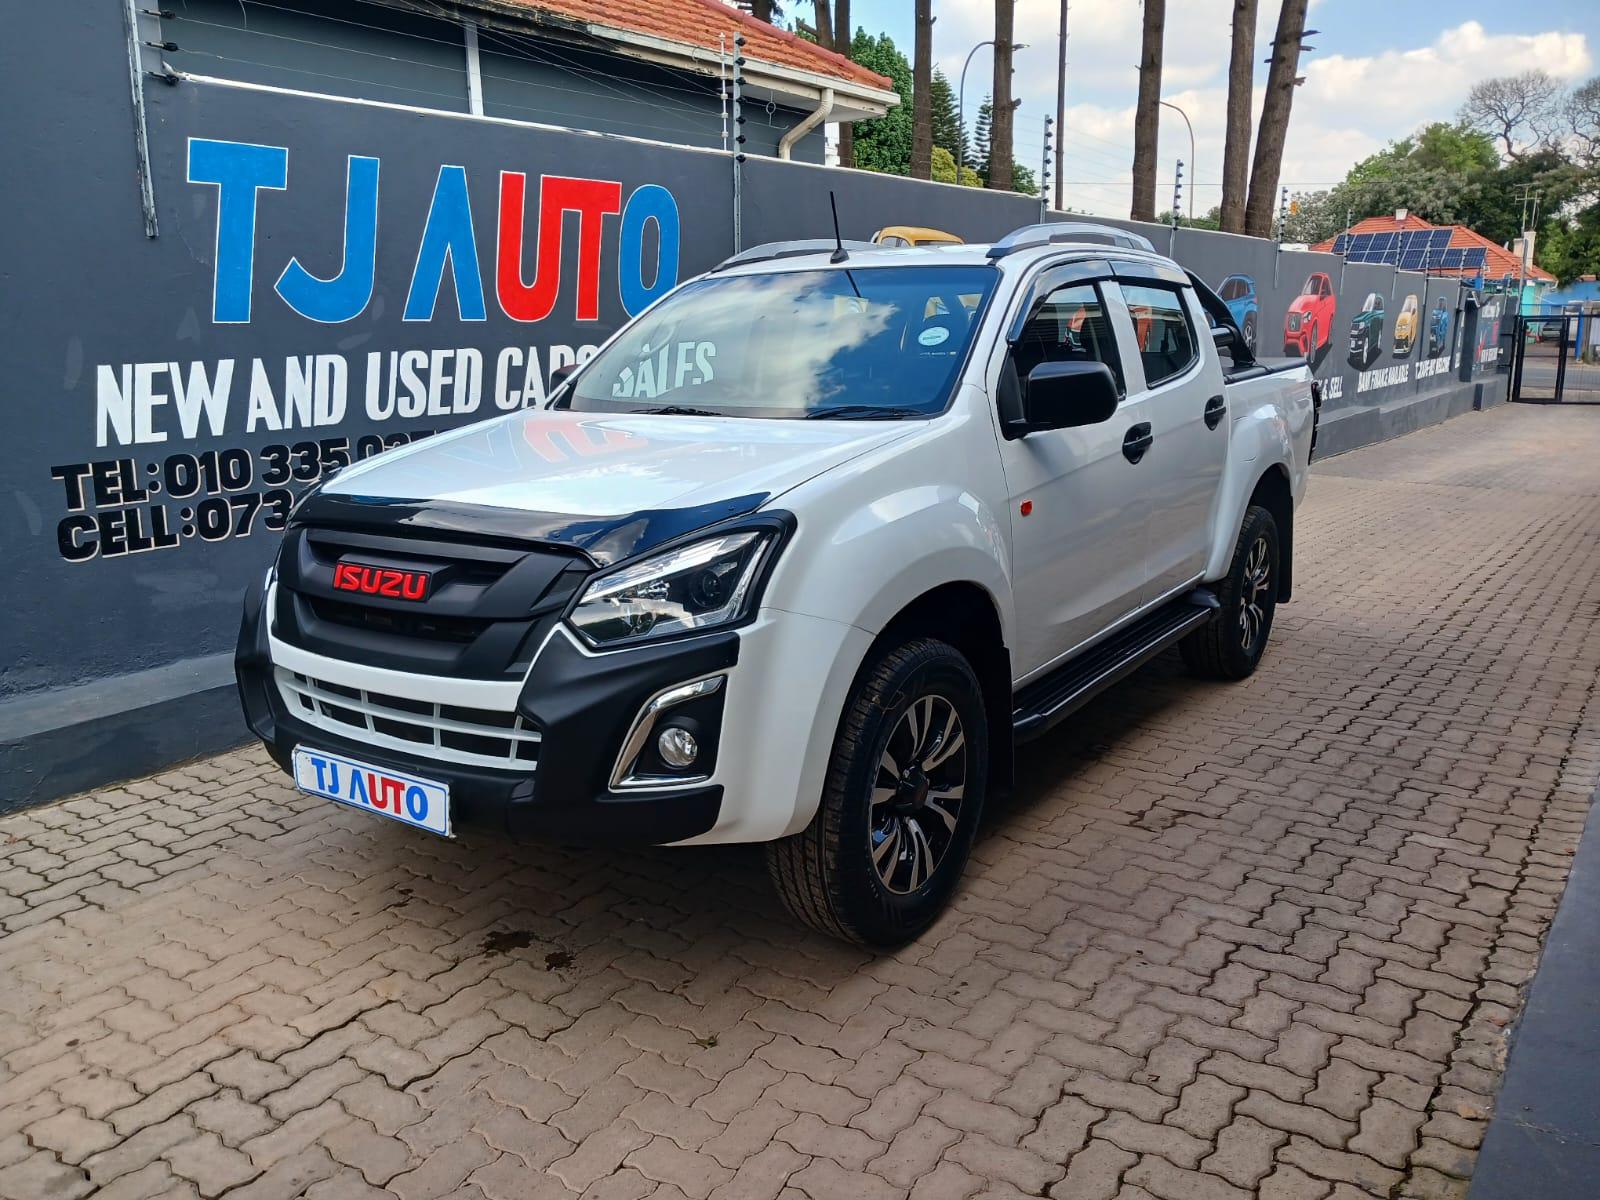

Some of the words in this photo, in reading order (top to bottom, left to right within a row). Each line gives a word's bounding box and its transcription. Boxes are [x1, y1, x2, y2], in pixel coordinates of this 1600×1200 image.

[187, 136, 380, 323] TJ
[402, 164, 680, 323] AUTO
[96, 359, 235, 447] NEW
[246, 354, 348, 433] AND
[365, 348, 483, 421] USED
[1329, 376, 1343, 399] SELL
[260, 438, 352, 488] 335
[334, 564, 426, 600] ISUZU
[311, 757, 340, 795] TJ
[350, 768, 428, 821] AUTO
